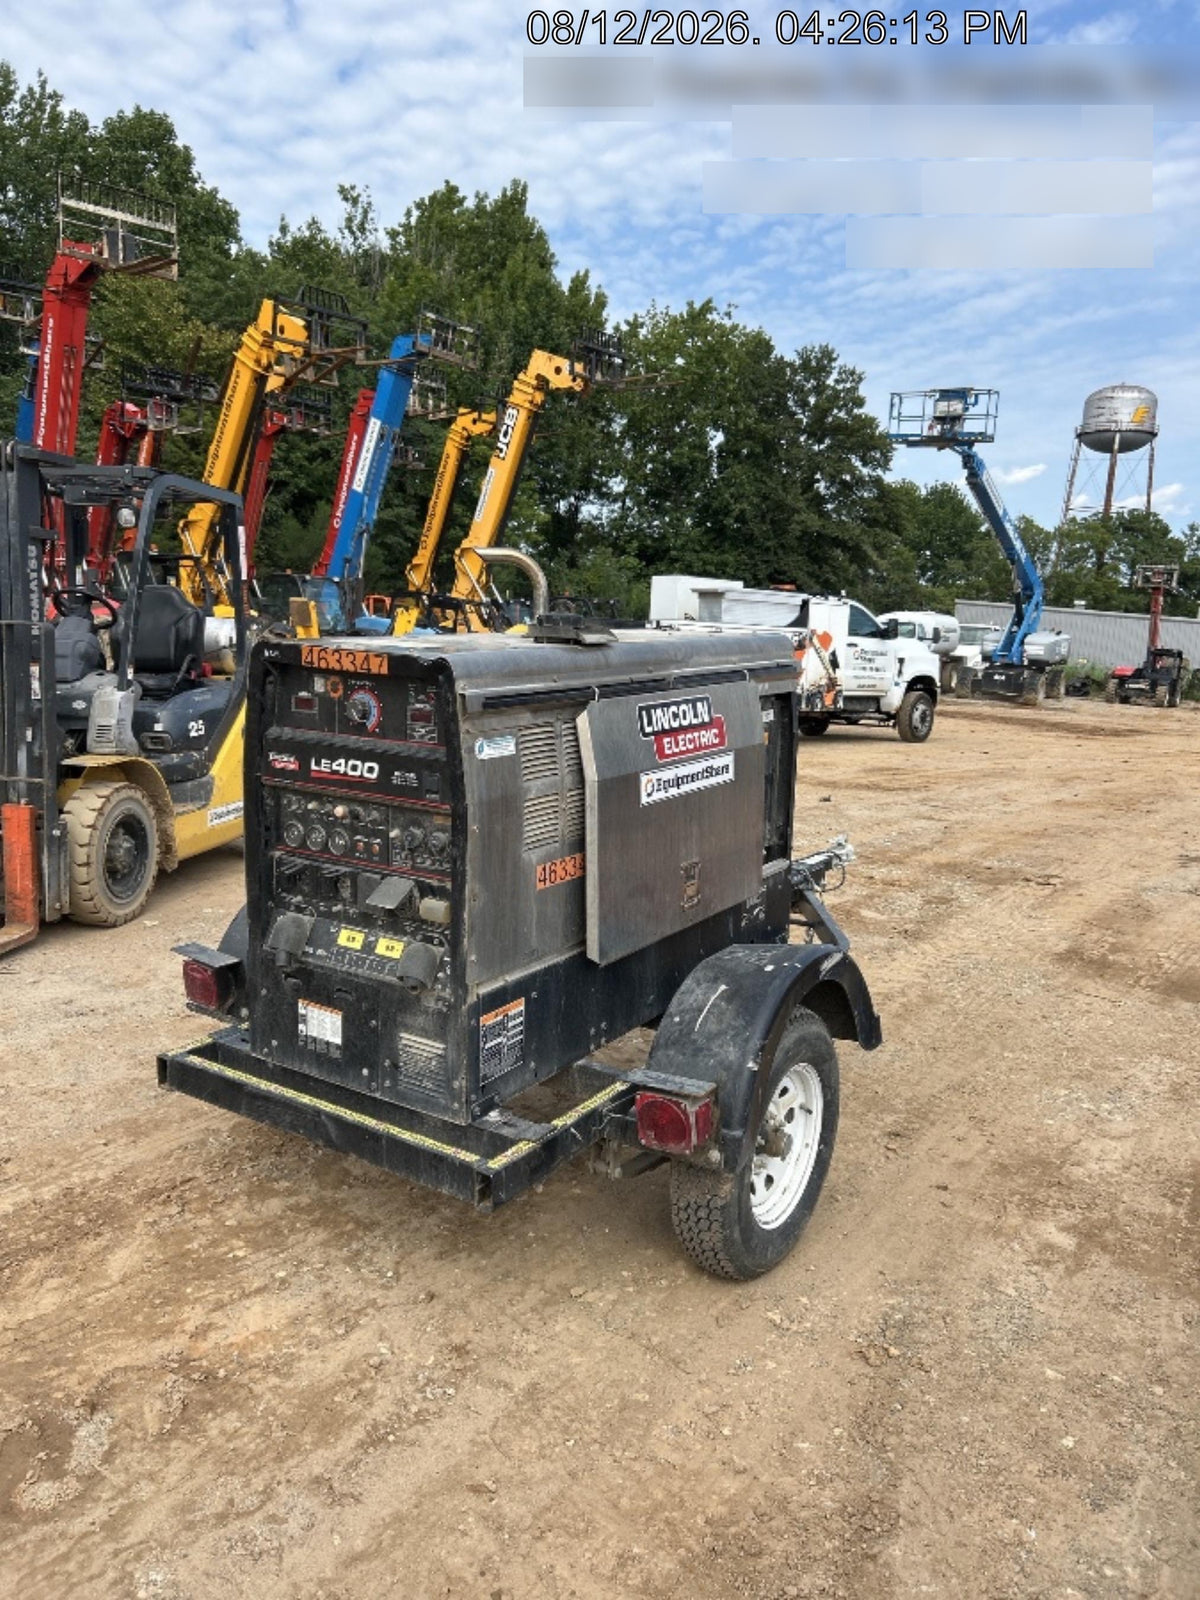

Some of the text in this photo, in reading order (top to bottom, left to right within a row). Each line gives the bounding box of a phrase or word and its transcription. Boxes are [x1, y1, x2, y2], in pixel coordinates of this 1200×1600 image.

[496, 408, 519, 459] JCB
[29, 544, 40, 636] KOMATSU
[304, 645, 386, 674] 463347
[188, 720, 205, 737] 25
[643, 701, 710, 733] LINCOLN
[664, 727, 720, 754] ELECTRIC
[310, 756, 380, 780] LE400
[655, 762, 731, 795] EquipmentShare
